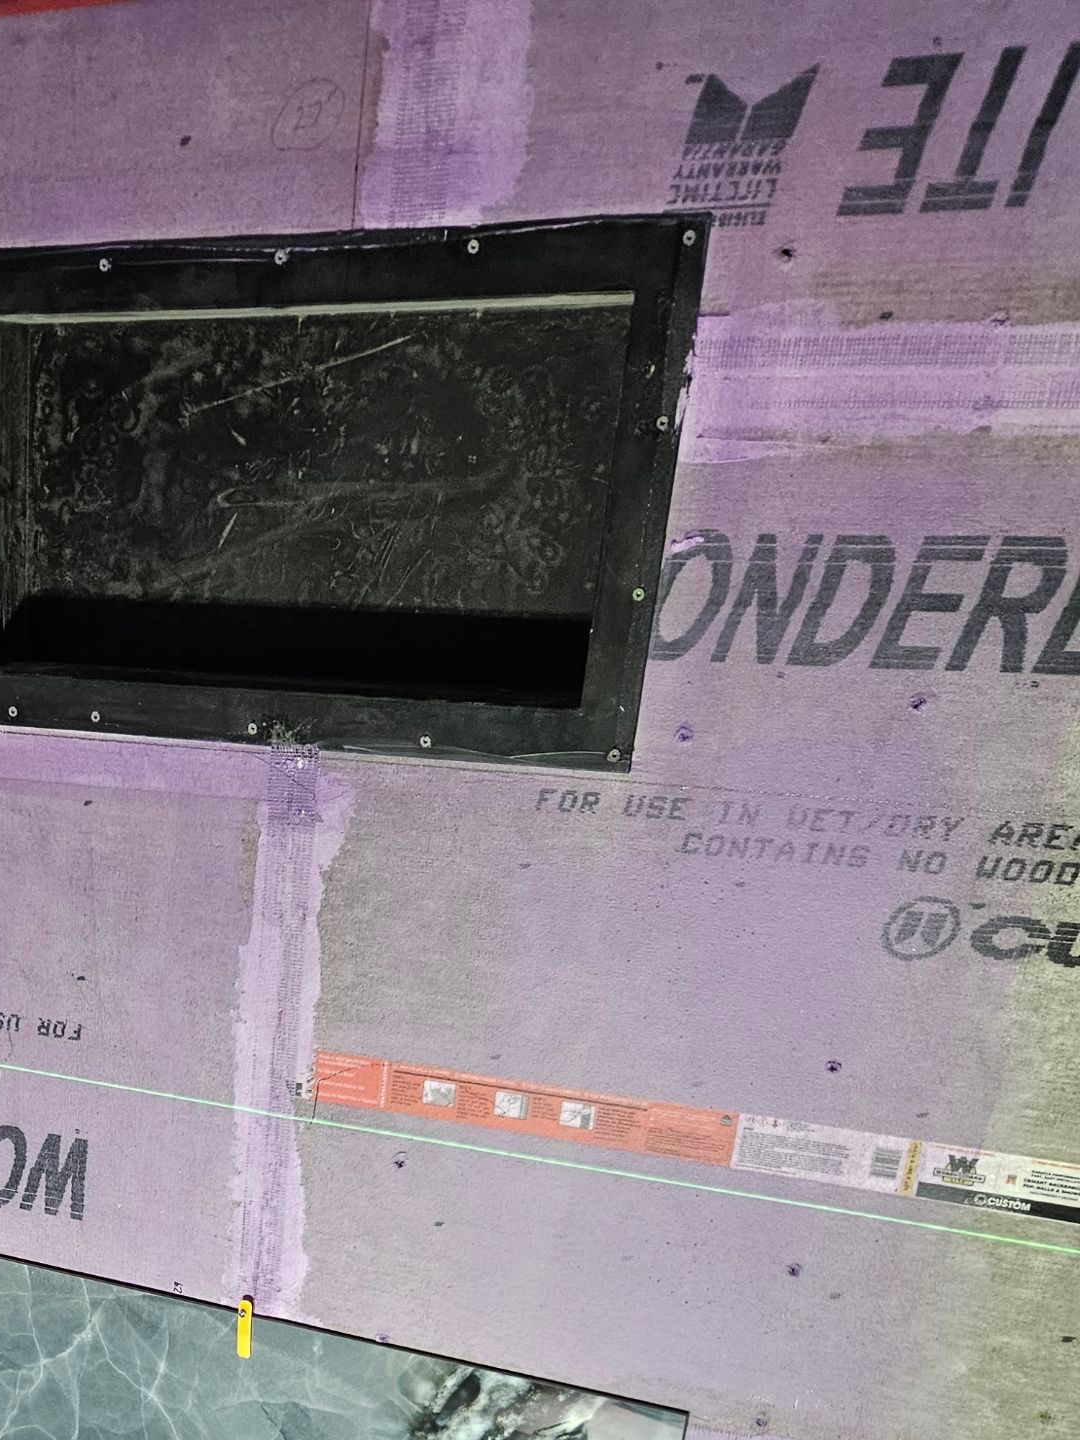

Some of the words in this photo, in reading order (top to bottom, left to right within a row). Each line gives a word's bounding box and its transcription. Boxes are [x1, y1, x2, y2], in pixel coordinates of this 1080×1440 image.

[534, 788, 600, 813] FOR
[623, 796, 687, 821] USE
[675, 832, 870, 868] CONTAINS
[896, 849, 947, 875] NO
[37, 1018, 83, 1041] FOR
[986, 1196, 1032, 1213] CUSTOM
